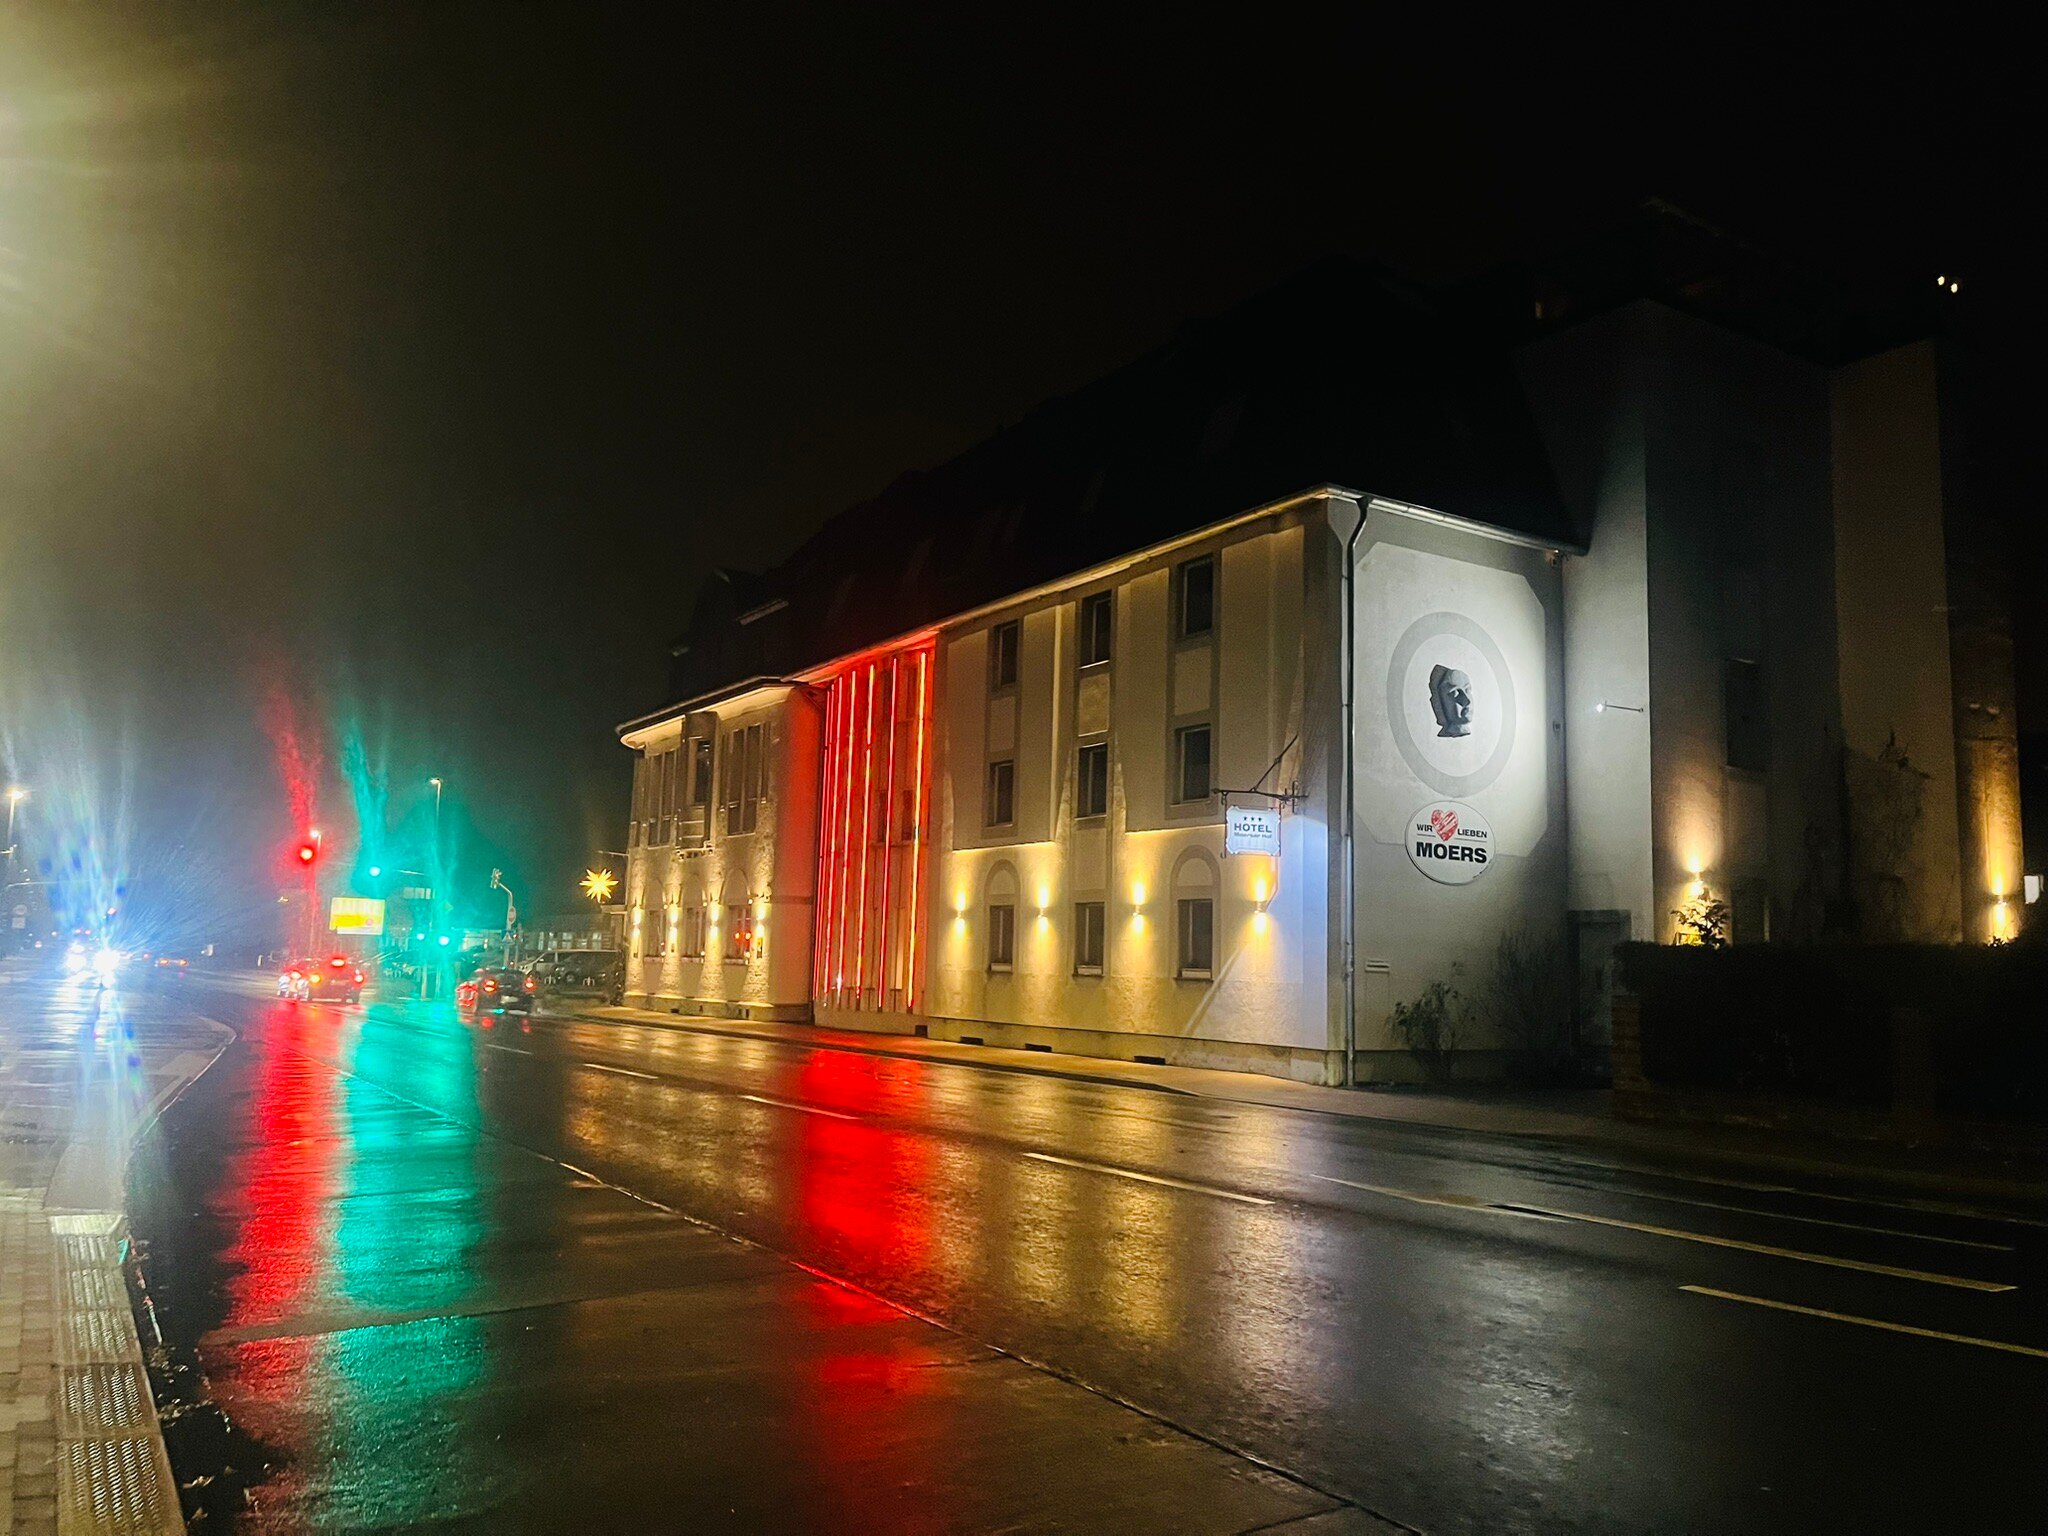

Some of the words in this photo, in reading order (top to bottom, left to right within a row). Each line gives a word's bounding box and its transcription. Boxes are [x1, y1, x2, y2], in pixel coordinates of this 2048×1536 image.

[1234, 823, 1272, 833] HOTEL
[1417, 824, 1433, 832] WIR
[1457, 828, 1487, 838] LIEBEN
[1417, 842, 1487, 863] MOERS
